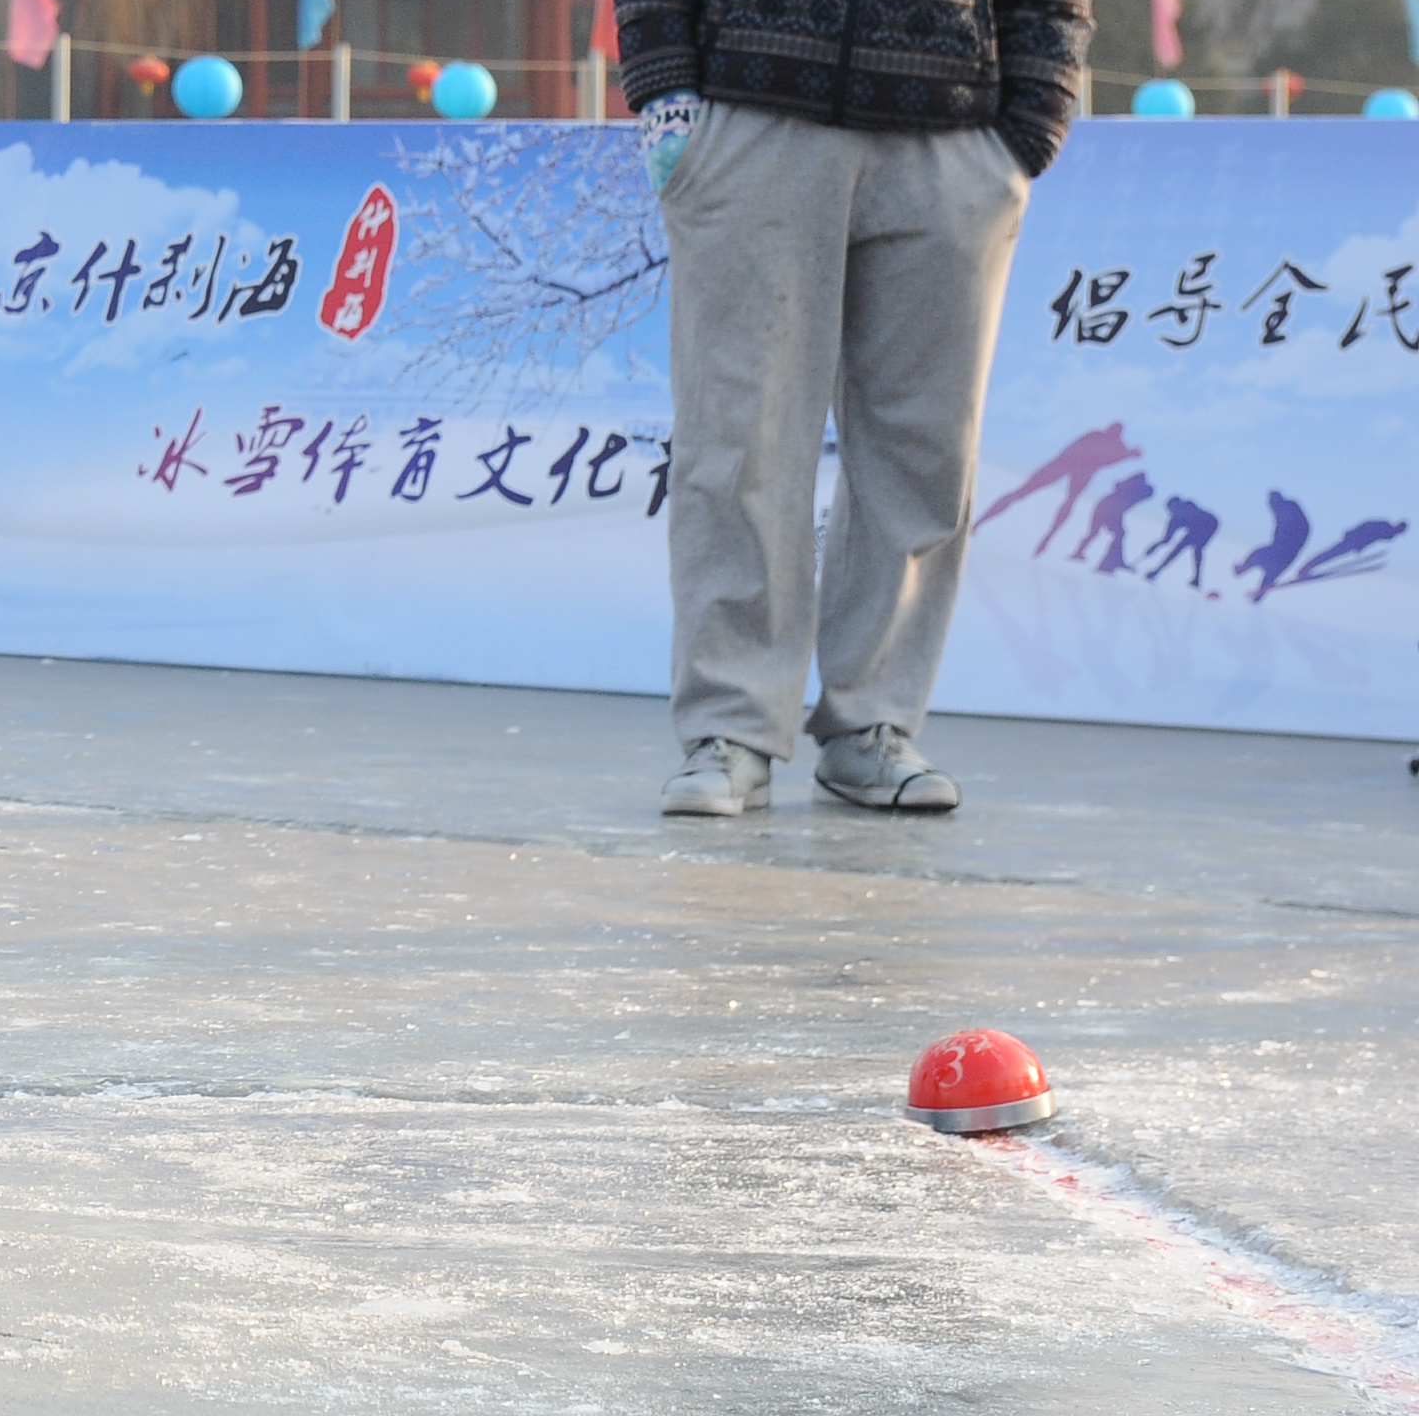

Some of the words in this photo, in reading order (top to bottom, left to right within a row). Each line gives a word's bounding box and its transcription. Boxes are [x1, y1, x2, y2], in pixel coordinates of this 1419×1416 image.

[1051, 253, 1419, 349] 倡导全民
[938, 1045, 967, 1088] 3
